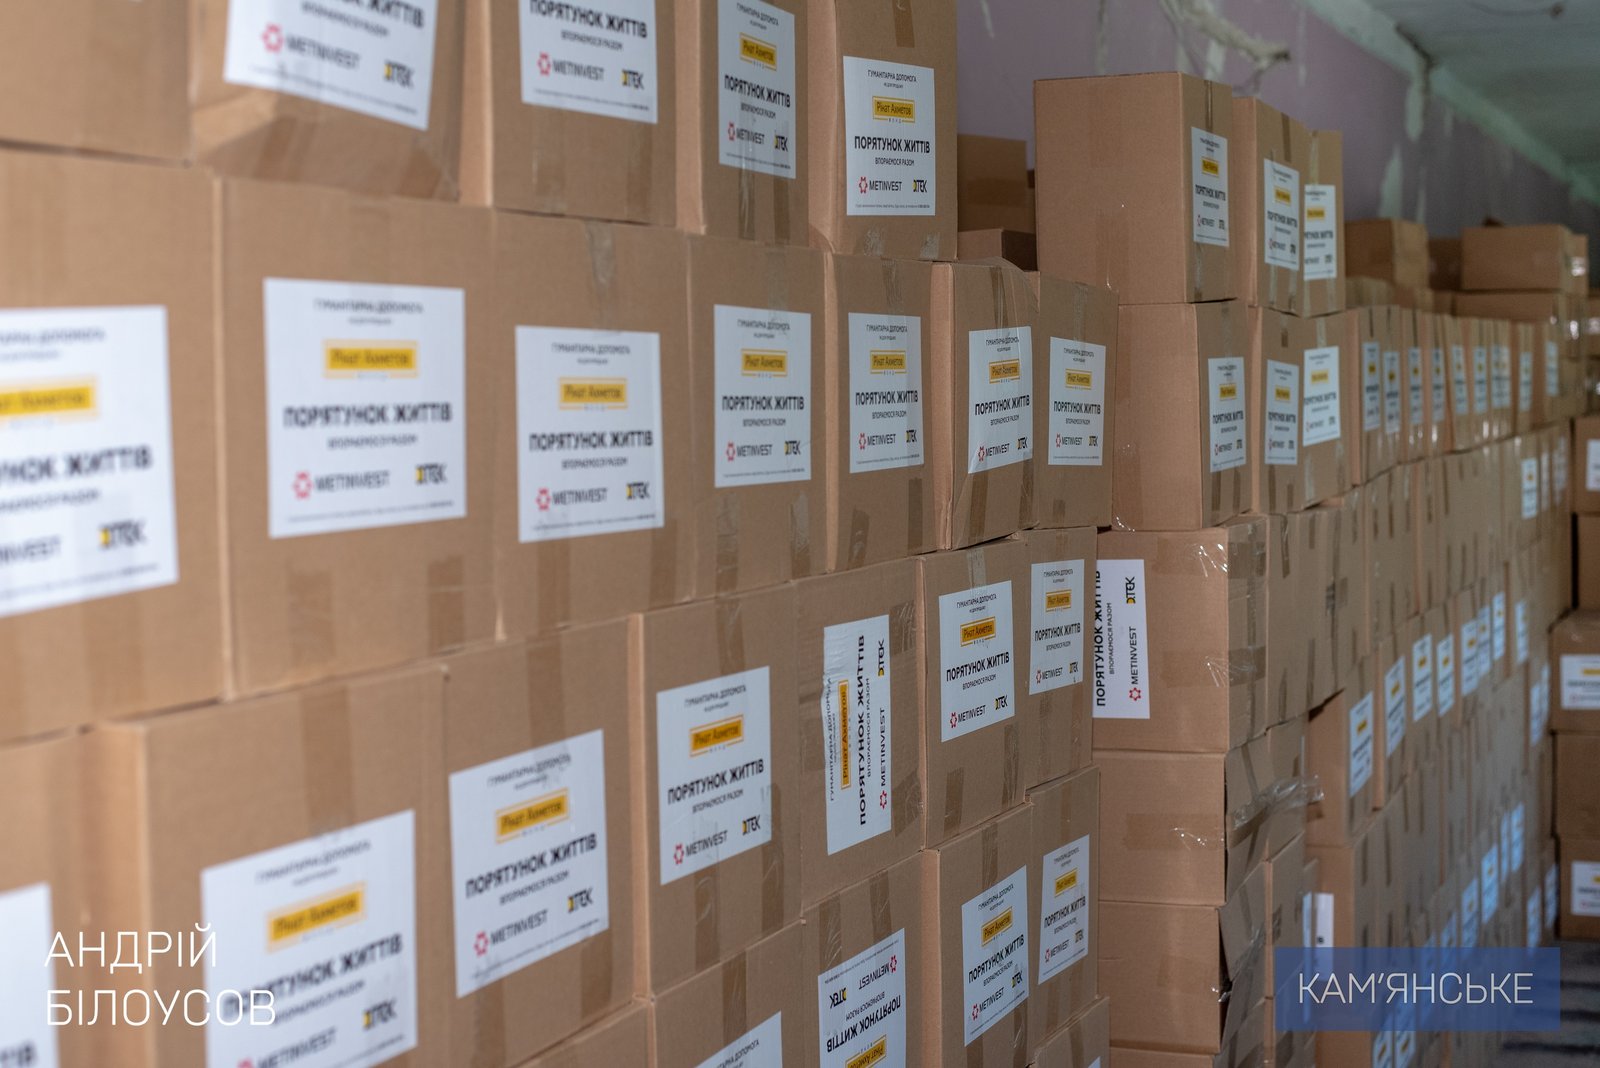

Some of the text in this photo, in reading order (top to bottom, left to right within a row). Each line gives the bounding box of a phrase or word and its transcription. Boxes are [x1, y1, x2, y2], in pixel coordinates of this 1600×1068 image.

[605, 12, 647, 38] ЖИТТІВ
[724, 75, 791, 108] ПОРЯТУНОК ЖИТТІВ
[854, 135, 930, 153] ПОРЯТУНОК ЖИТТІВ
[868, 180, 902, 191] METINVEST
[722, 396, 804, 410] ПОРЯТУНОК ЖИТТІВ
[855, 390, 919, 405] ПОРЯТУНОК ЖИТТІВ
[974, 395, 1030, 415] ПОРЯТУНОК ЖИТТІВ
[1053, 400, 1101, 415] ПОРЯТУНОК ЖИТТІВ
[529, 430, 653, 451] ПОРЯТУНОК ЖИТТІВ
[866, 433, 896, 446] METINVEST
[984, 443, 1009, 457] METINVEST
[1034, 622, 1081, 641] ПОРЯТУНОК ЖИТТІВ
[946, 651, 1009, 681] ПОРЯТУНОК ЖИТТІВ
[1094, 626, 1105, 706] ПОРЯТУНОК
[1129, 626, 1138, 685] METINVEST
[1041, 667, 1063, 680] METINVEST
[957, 704, 985, 723] METINVEST
[856, 635, 866, 825] ПОРЯТУНОК ЖИТТІВ
[667, 758, 764, 805] ПОРЯТУНОК ЖИТТІВ
[685, 829, 727, 857] METINVEST
[466, 831, 597, 899] ПОРЯТУНОК ЖИТТІВ
[968, 934, 1024, 984] ПОРЯТУНОК ЖИТТІВ
[858, 962, 890, 990] METINVEST
[978, 987, 1004, 1014] METINVEST
[826, 994, 901, 1053] ПОРЯТУНОК ЖИТТІВ
